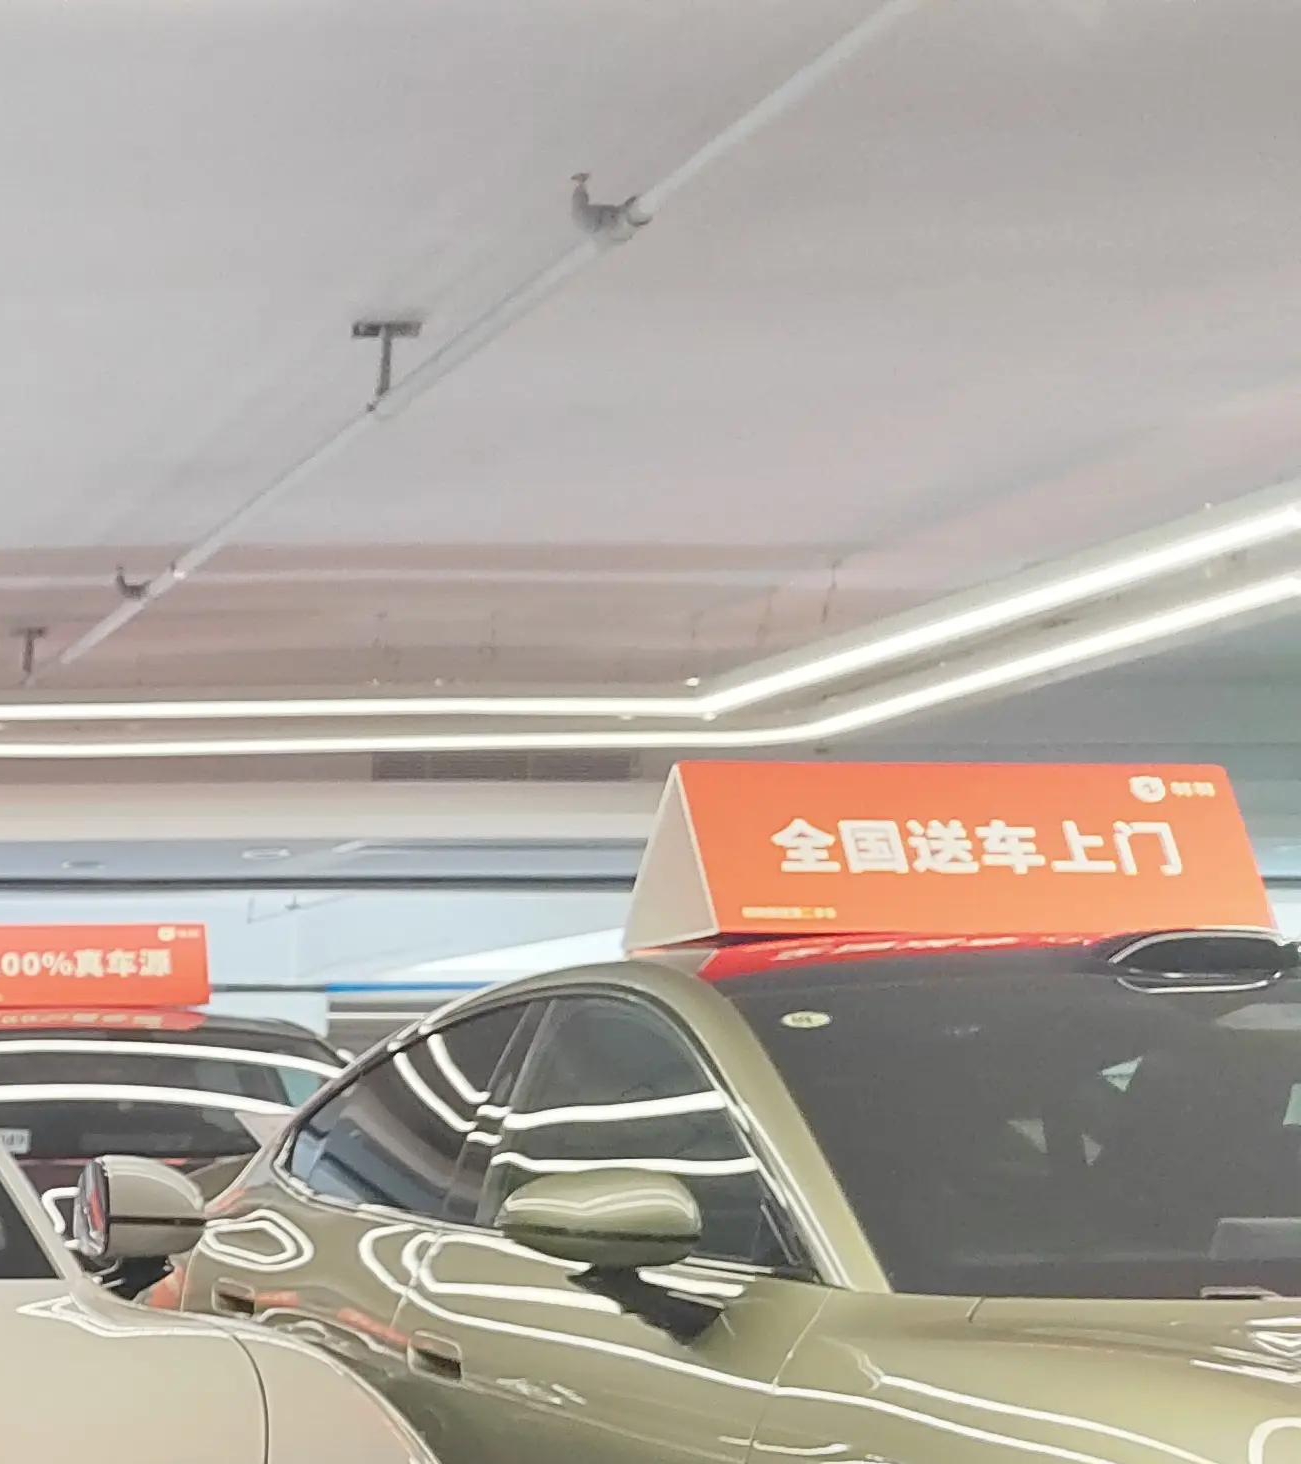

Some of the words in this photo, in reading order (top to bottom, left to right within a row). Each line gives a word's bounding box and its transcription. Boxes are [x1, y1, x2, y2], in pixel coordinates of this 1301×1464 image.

[771, 818, 1183, 876] 全国送车上门
